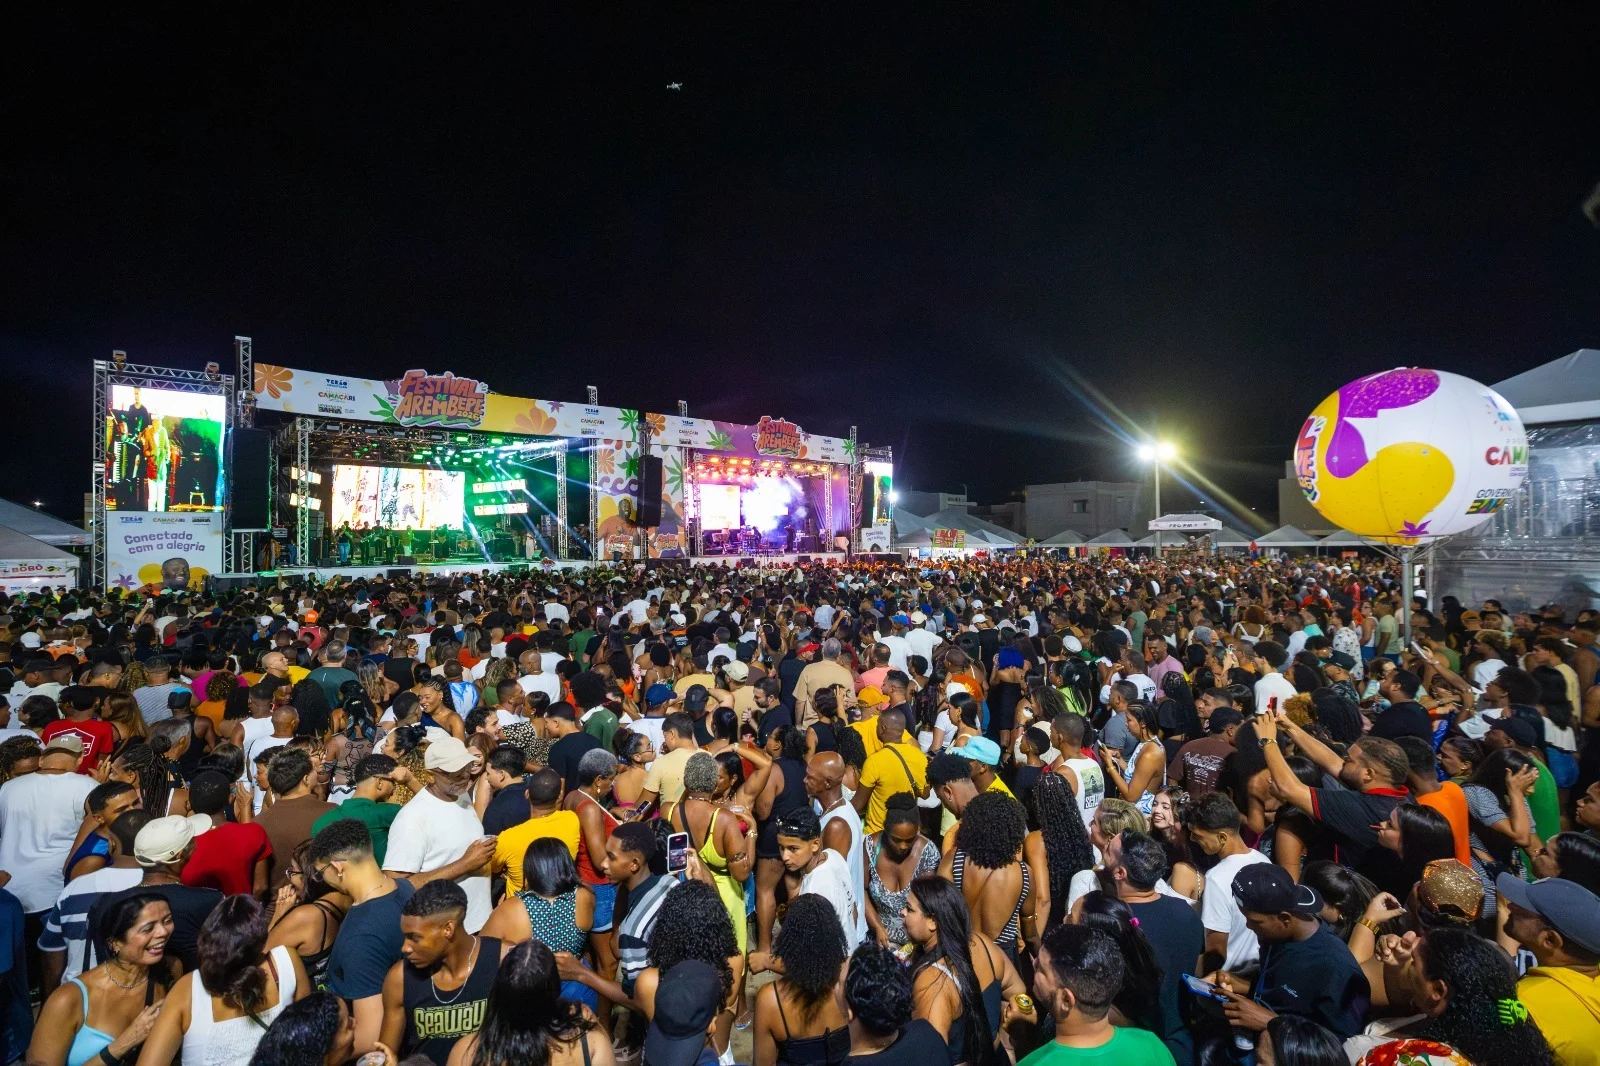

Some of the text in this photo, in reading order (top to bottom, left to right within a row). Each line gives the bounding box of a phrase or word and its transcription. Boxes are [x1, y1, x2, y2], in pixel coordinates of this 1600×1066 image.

[400, 371, 485, 398] FESTIVAL
[395, 392, 485, 419] AREMBEPE
[457, 410, 479, 420] 2026
[758, 417, 800, 438] FESTIVAL
[757, 431, 800, 450] AREMBEPE
[124, 531, 193, 545] Conectado
[128, 540, 206, 555] com a alegria
[414, 999, 488, 1040] Seaway
